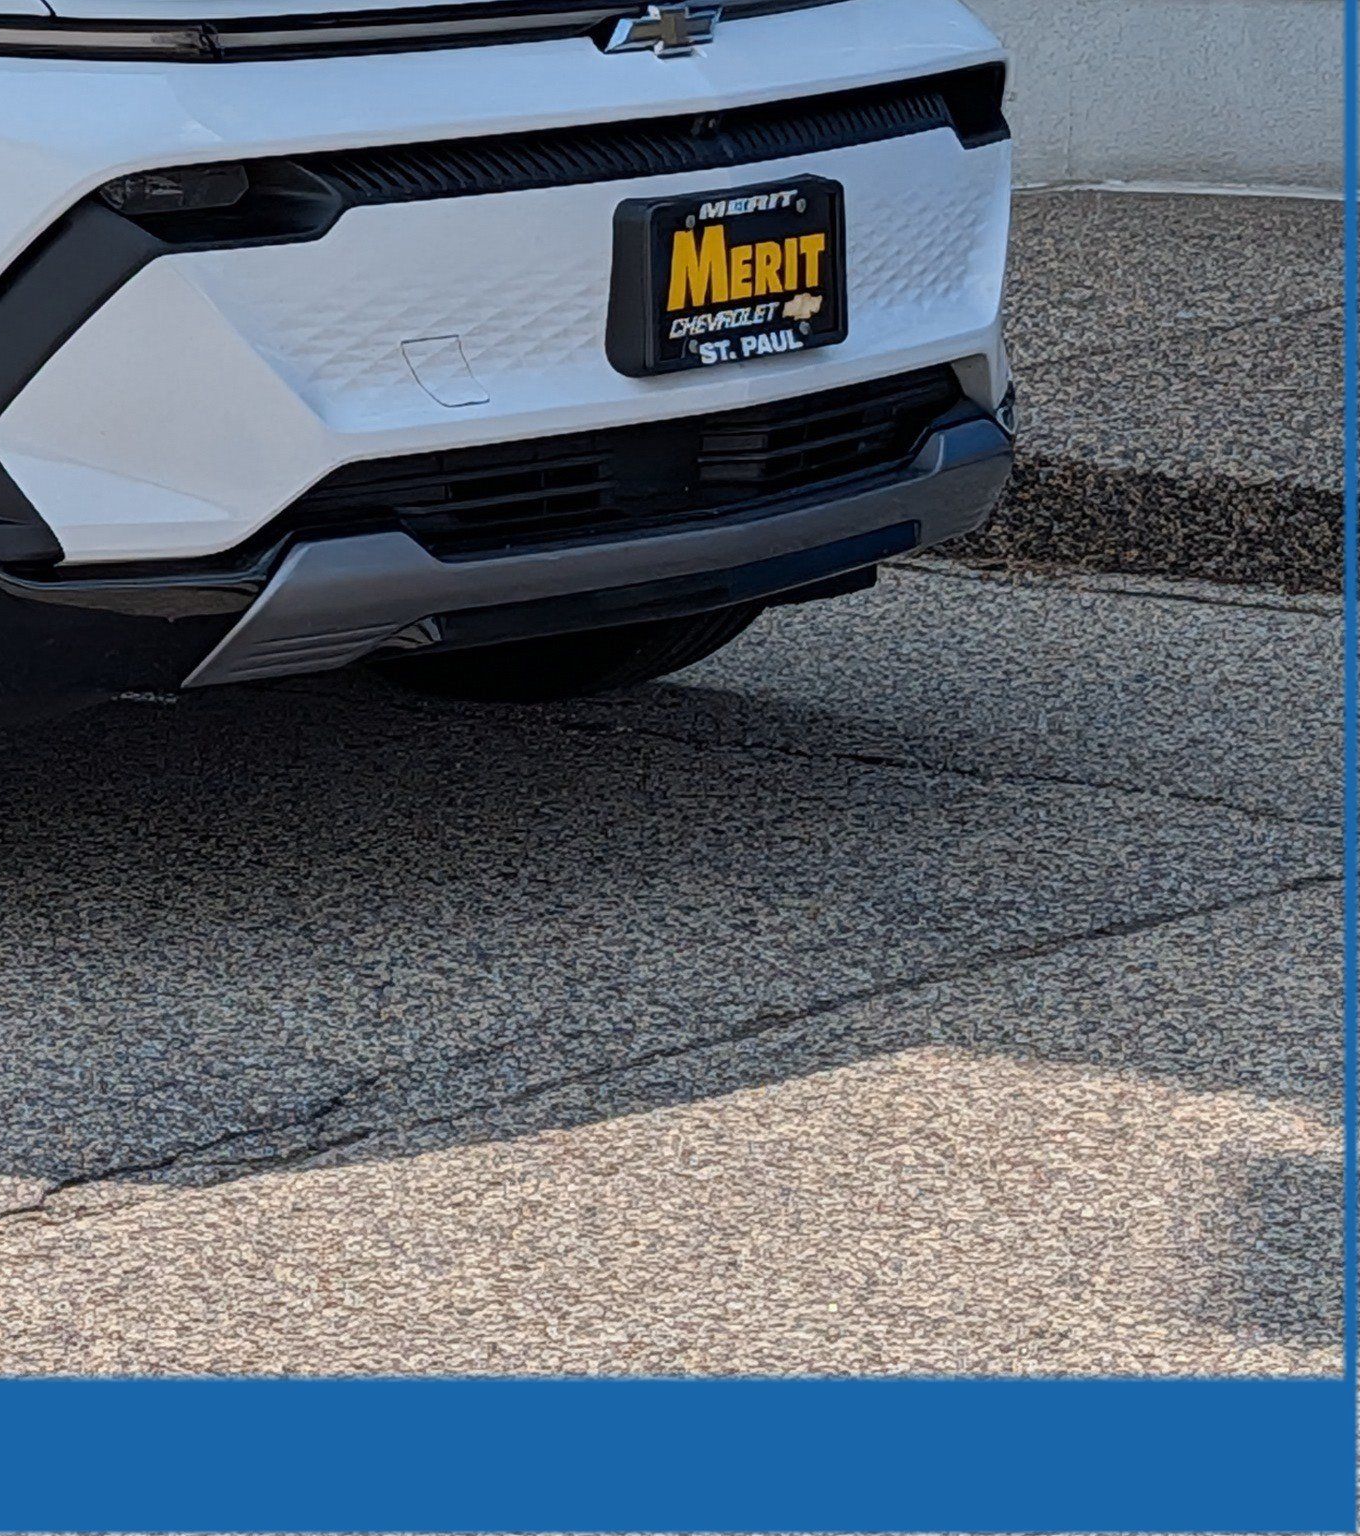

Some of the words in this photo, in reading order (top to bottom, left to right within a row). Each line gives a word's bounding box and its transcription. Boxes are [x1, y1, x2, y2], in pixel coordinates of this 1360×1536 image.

[698, 189, 799, 220] MERIT
[666, 224, 826, 312] MERIT
[668, 301, 781, 340] CHEVROLET
[699, 339, 737, 365] ST.
[740, 329, 804, 356] PAUL
